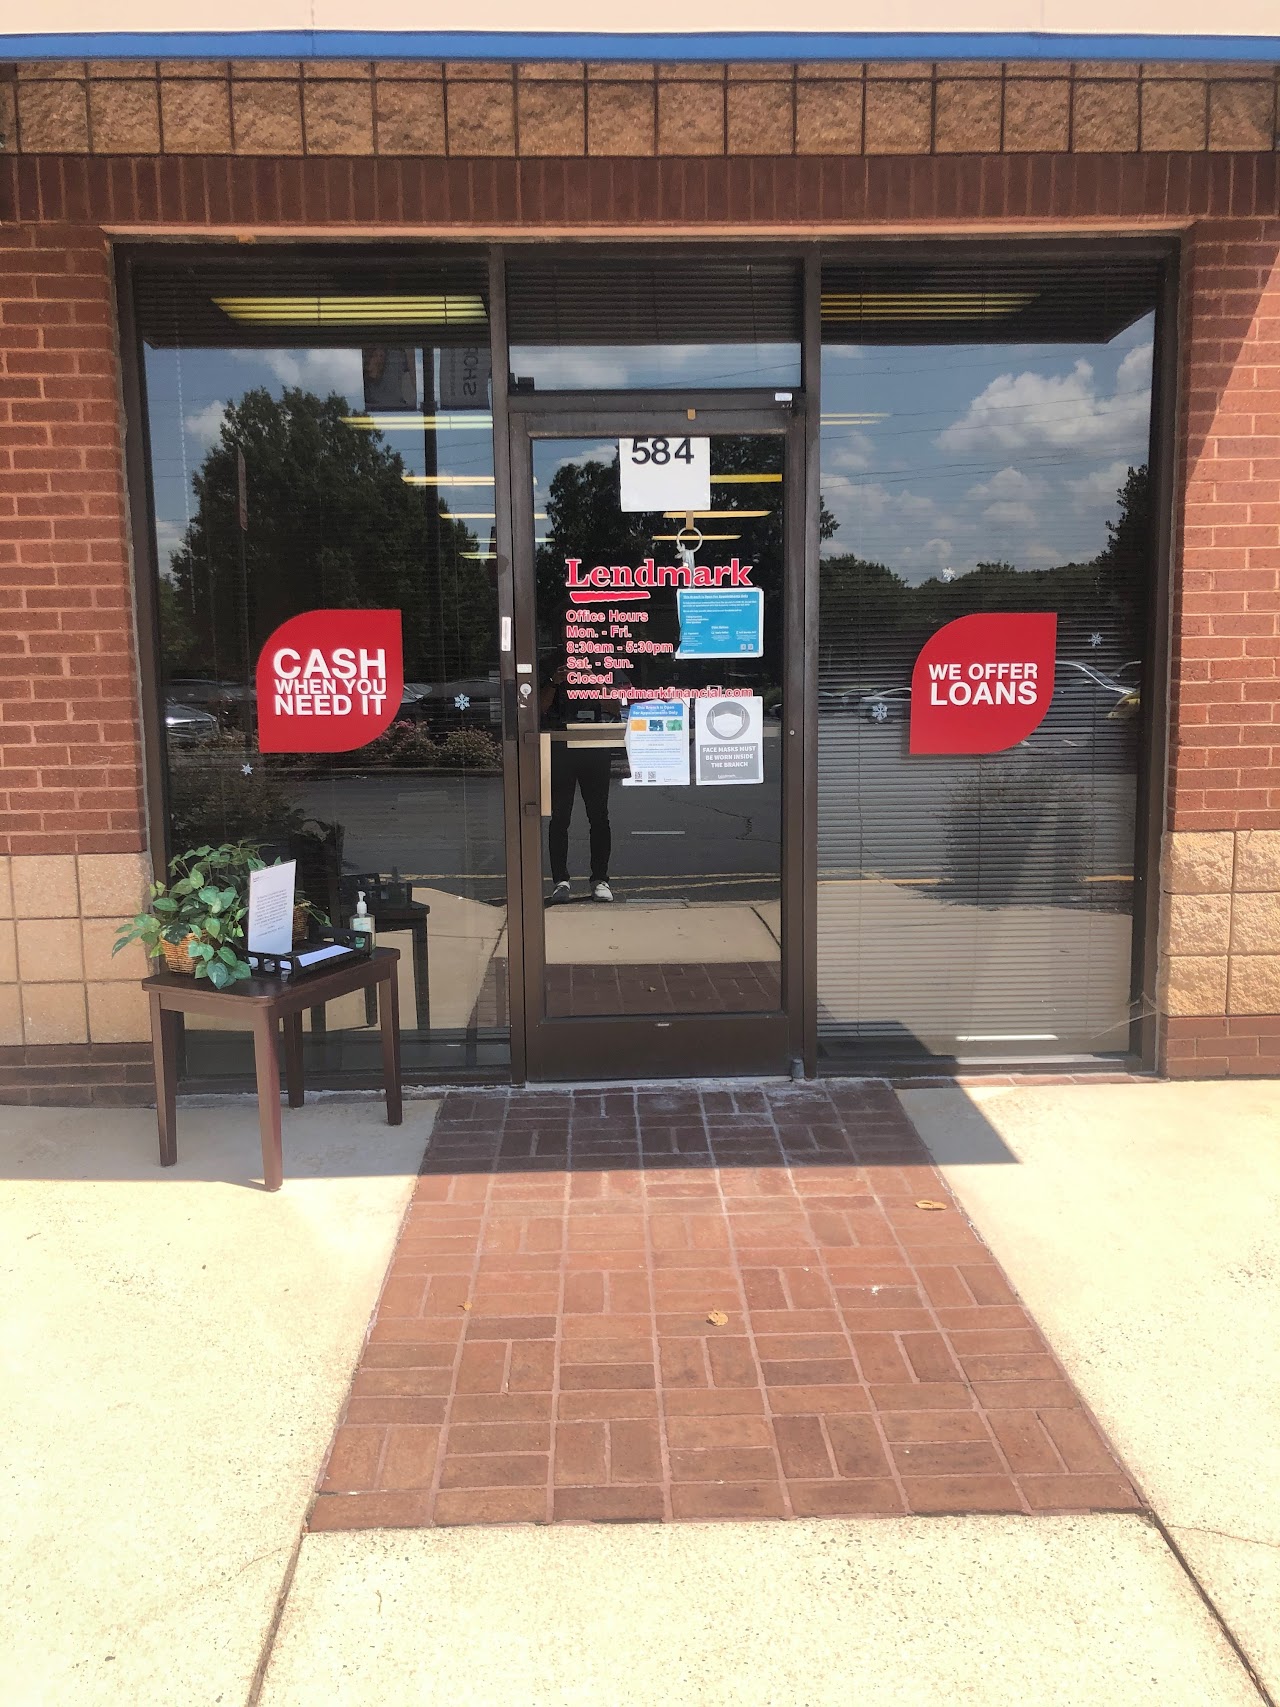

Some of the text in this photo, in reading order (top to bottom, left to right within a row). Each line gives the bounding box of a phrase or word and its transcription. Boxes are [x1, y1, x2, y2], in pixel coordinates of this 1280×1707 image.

[631, 437, 695, 466] 584
[565, 558, 753, 587] Lendmark
[566, 610, 648, 622] Office Hours
[566, 625, 599, 638] Mon.
[610, 625, 632, 638] Fri.
[566, 641, 614, 653] 8:30am
[625, 641, 674, 655] 5:30pm
[273, 648, 387, 680] CASH
[566, 657, 592, 669] Sat.
[603, 656, 634, 669] Sun.
[567, 672, 613, 684] Closed
[928, 663, 1038, 680] WE OFFER
[274, 679, 387, 695] WHEN YOU
[567, 687, 753, 699] www.Lendmarkfinancial.com
[930, 681, 1038, 706] LOANS
[274, 694, 387, 716] NEED IT
